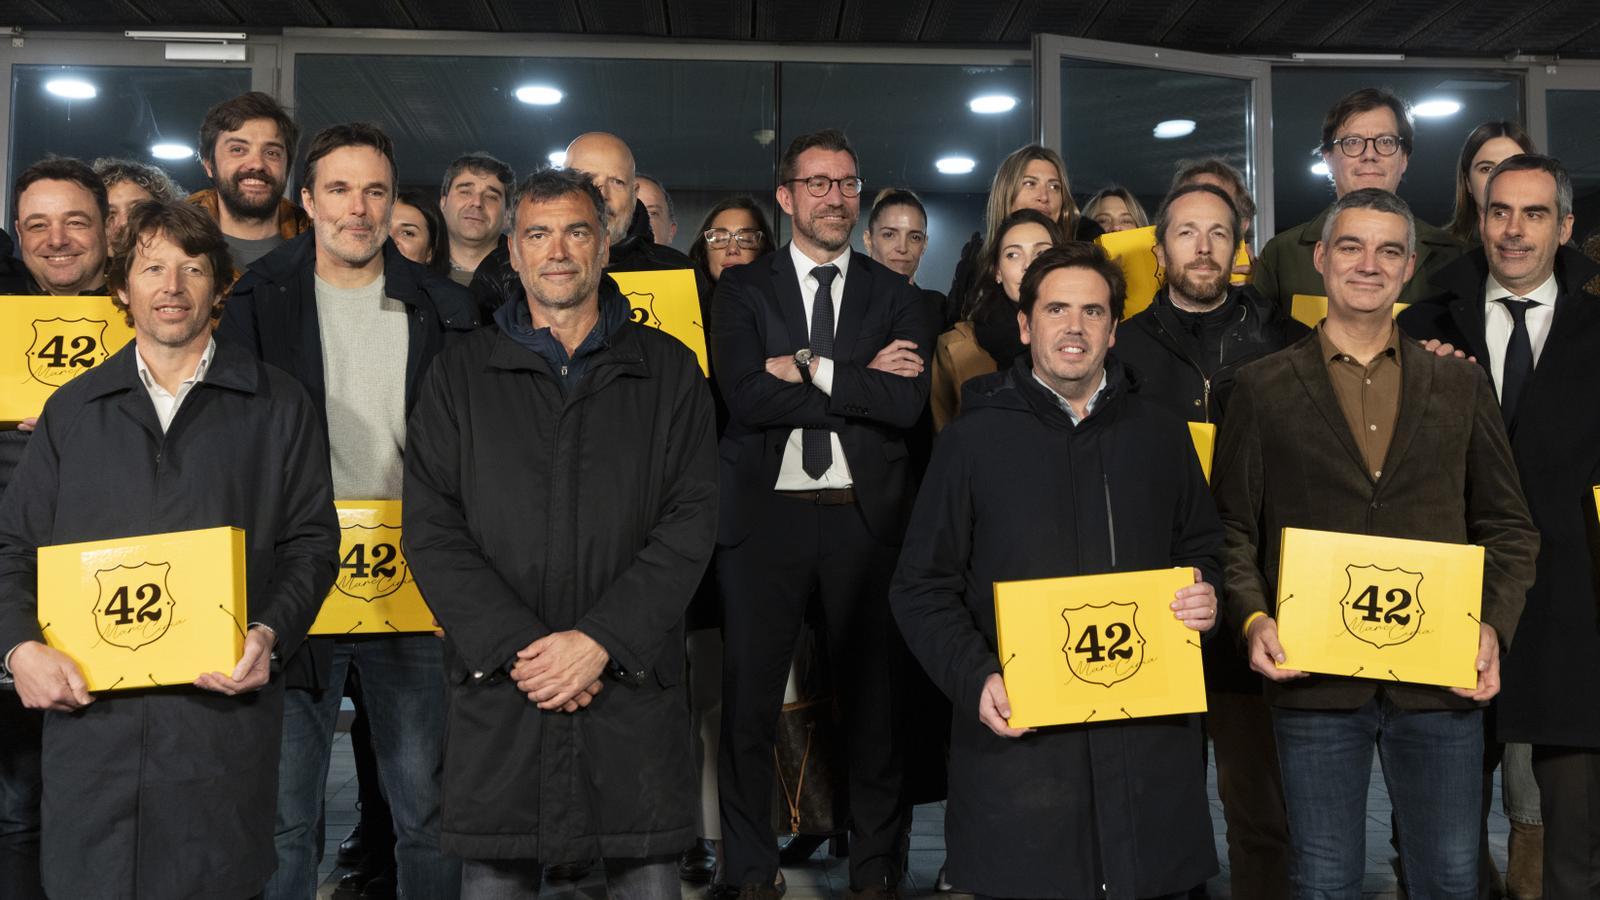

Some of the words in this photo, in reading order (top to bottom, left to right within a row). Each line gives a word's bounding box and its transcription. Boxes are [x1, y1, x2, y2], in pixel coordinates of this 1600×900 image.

[37, 335, 97, 368] 42
[339, 543, 397, 578] 42
[104, 583, 162, 625] 42
[1351, 585, 1412, 626] 42
[1074, 622, 1134, 663] 42
